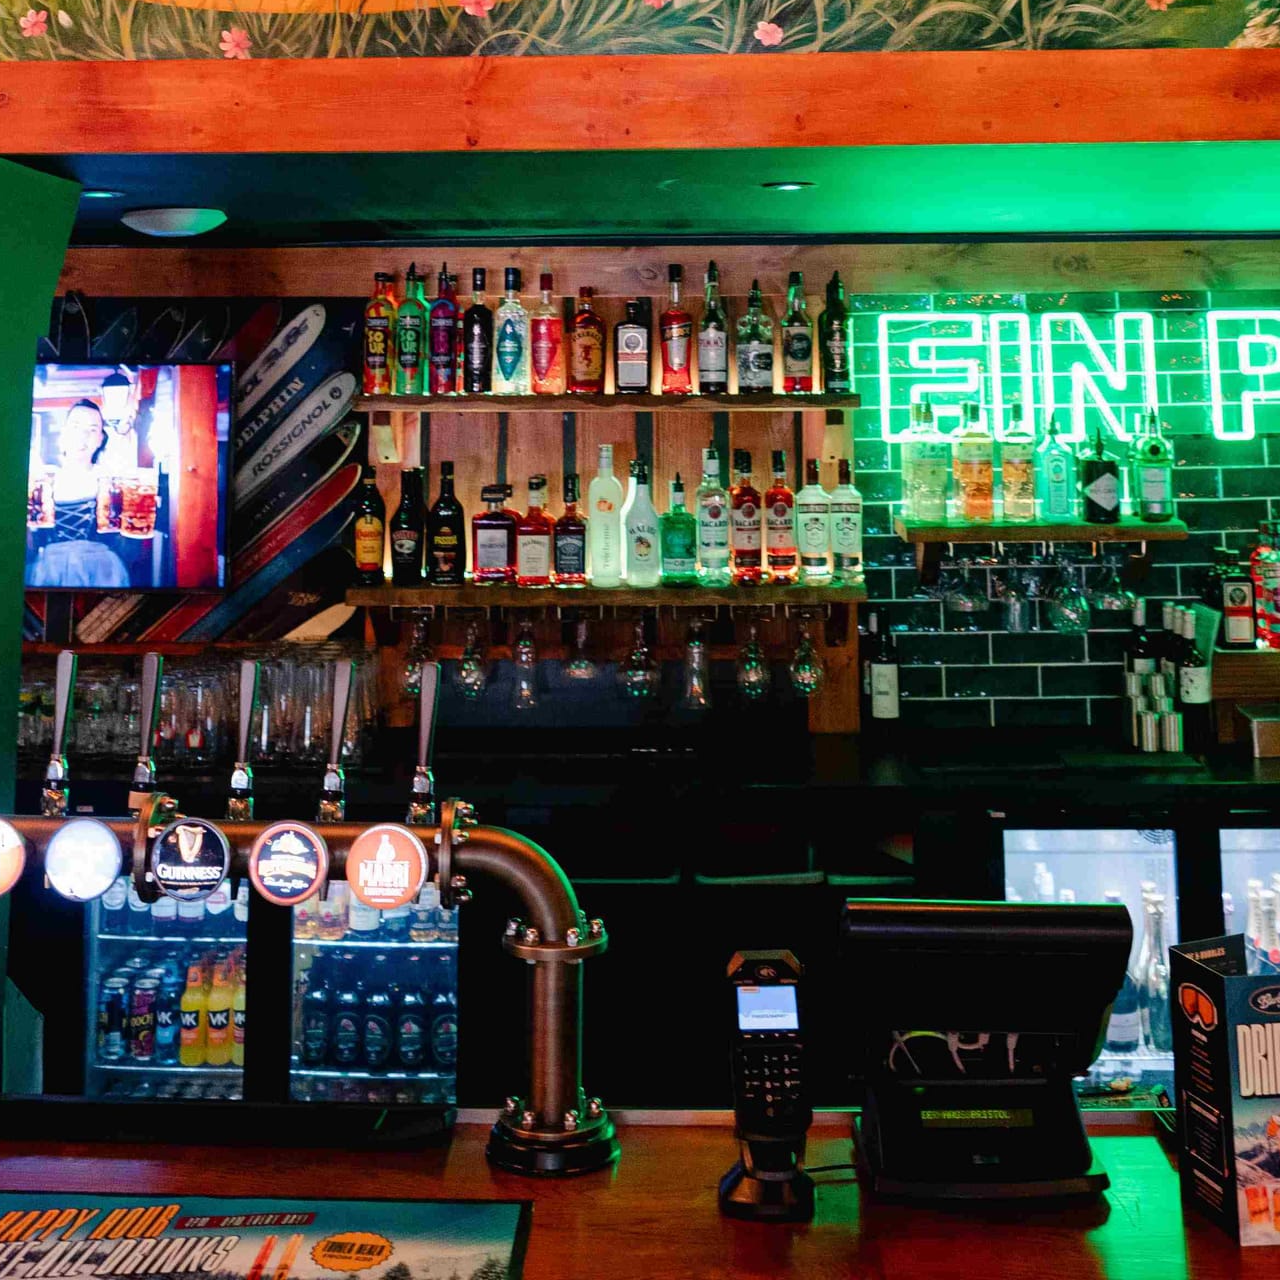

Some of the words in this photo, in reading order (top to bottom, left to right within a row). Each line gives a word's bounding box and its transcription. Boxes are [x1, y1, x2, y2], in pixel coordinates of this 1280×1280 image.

[878, 311, 1154, 442] EIN
[252, 399, 333, 476] ROSSIGNOL
[156, 863, 223, 882] GUINNESS
[180, 1012, 197, 1027] VK
[208, 1011, 230, 1026] VK
[88, 1204, 181, 1240] HOUR
[19, 1238, 103, 1279] ALL
[92, 1234, 242, 1276] DRINKS
